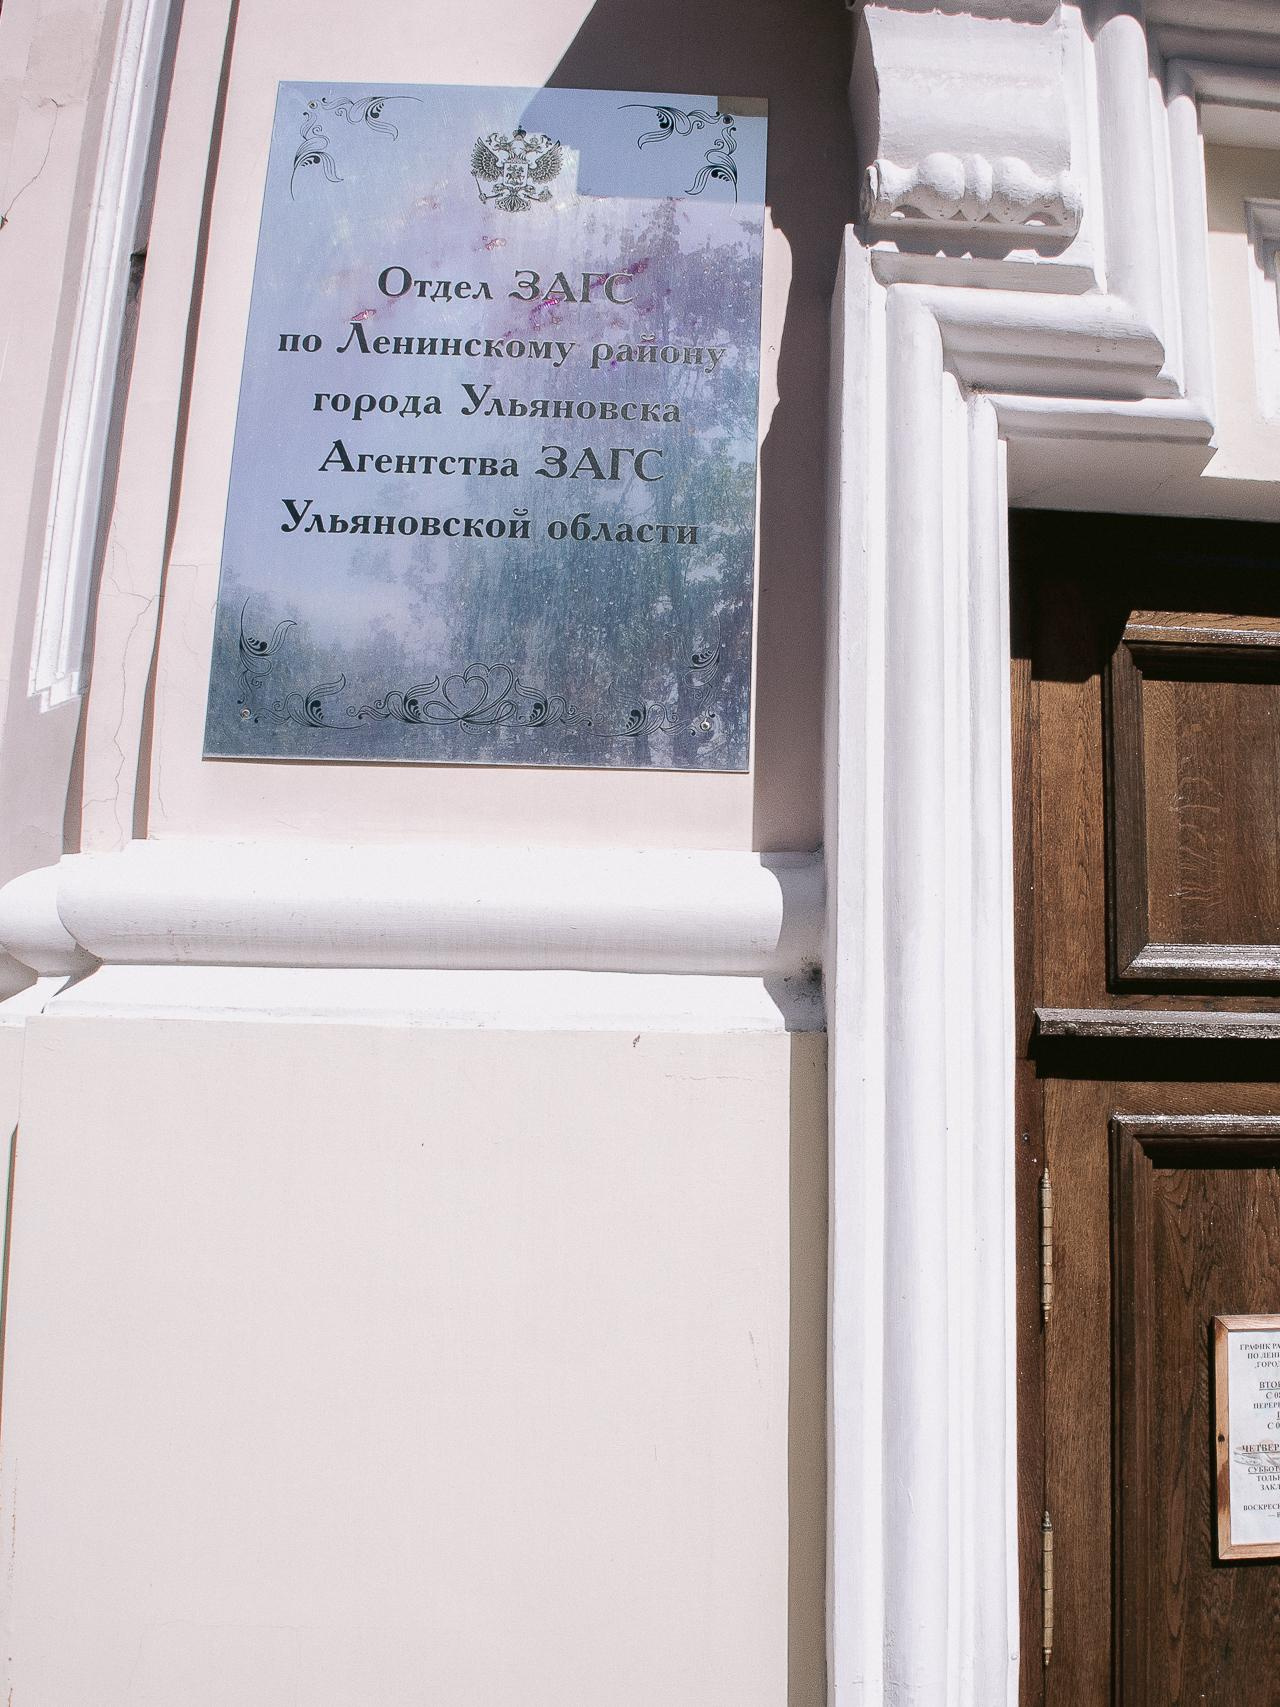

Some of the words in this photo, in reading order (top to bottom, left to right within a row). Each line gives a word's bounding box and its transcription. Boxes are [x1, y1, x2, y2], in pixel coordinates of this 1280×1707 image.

[377, 265, 494, 301] Отдел
[509, 269, 634, 305] ЗАГС
[278, 335, 323, 353] по
[337, 321, 576, 368] Ленинскому
[590, 335, 726, 374] району
[313, 392, 443, 425] города
[461, 383, 681, 423] Ульяновска
[318, 439, 519, 478] Агентства
[534, 445, 664, 482] ЗАГС
[281, 498, 531, 541] Ульяновской
[547, 512, 699, 546] области
